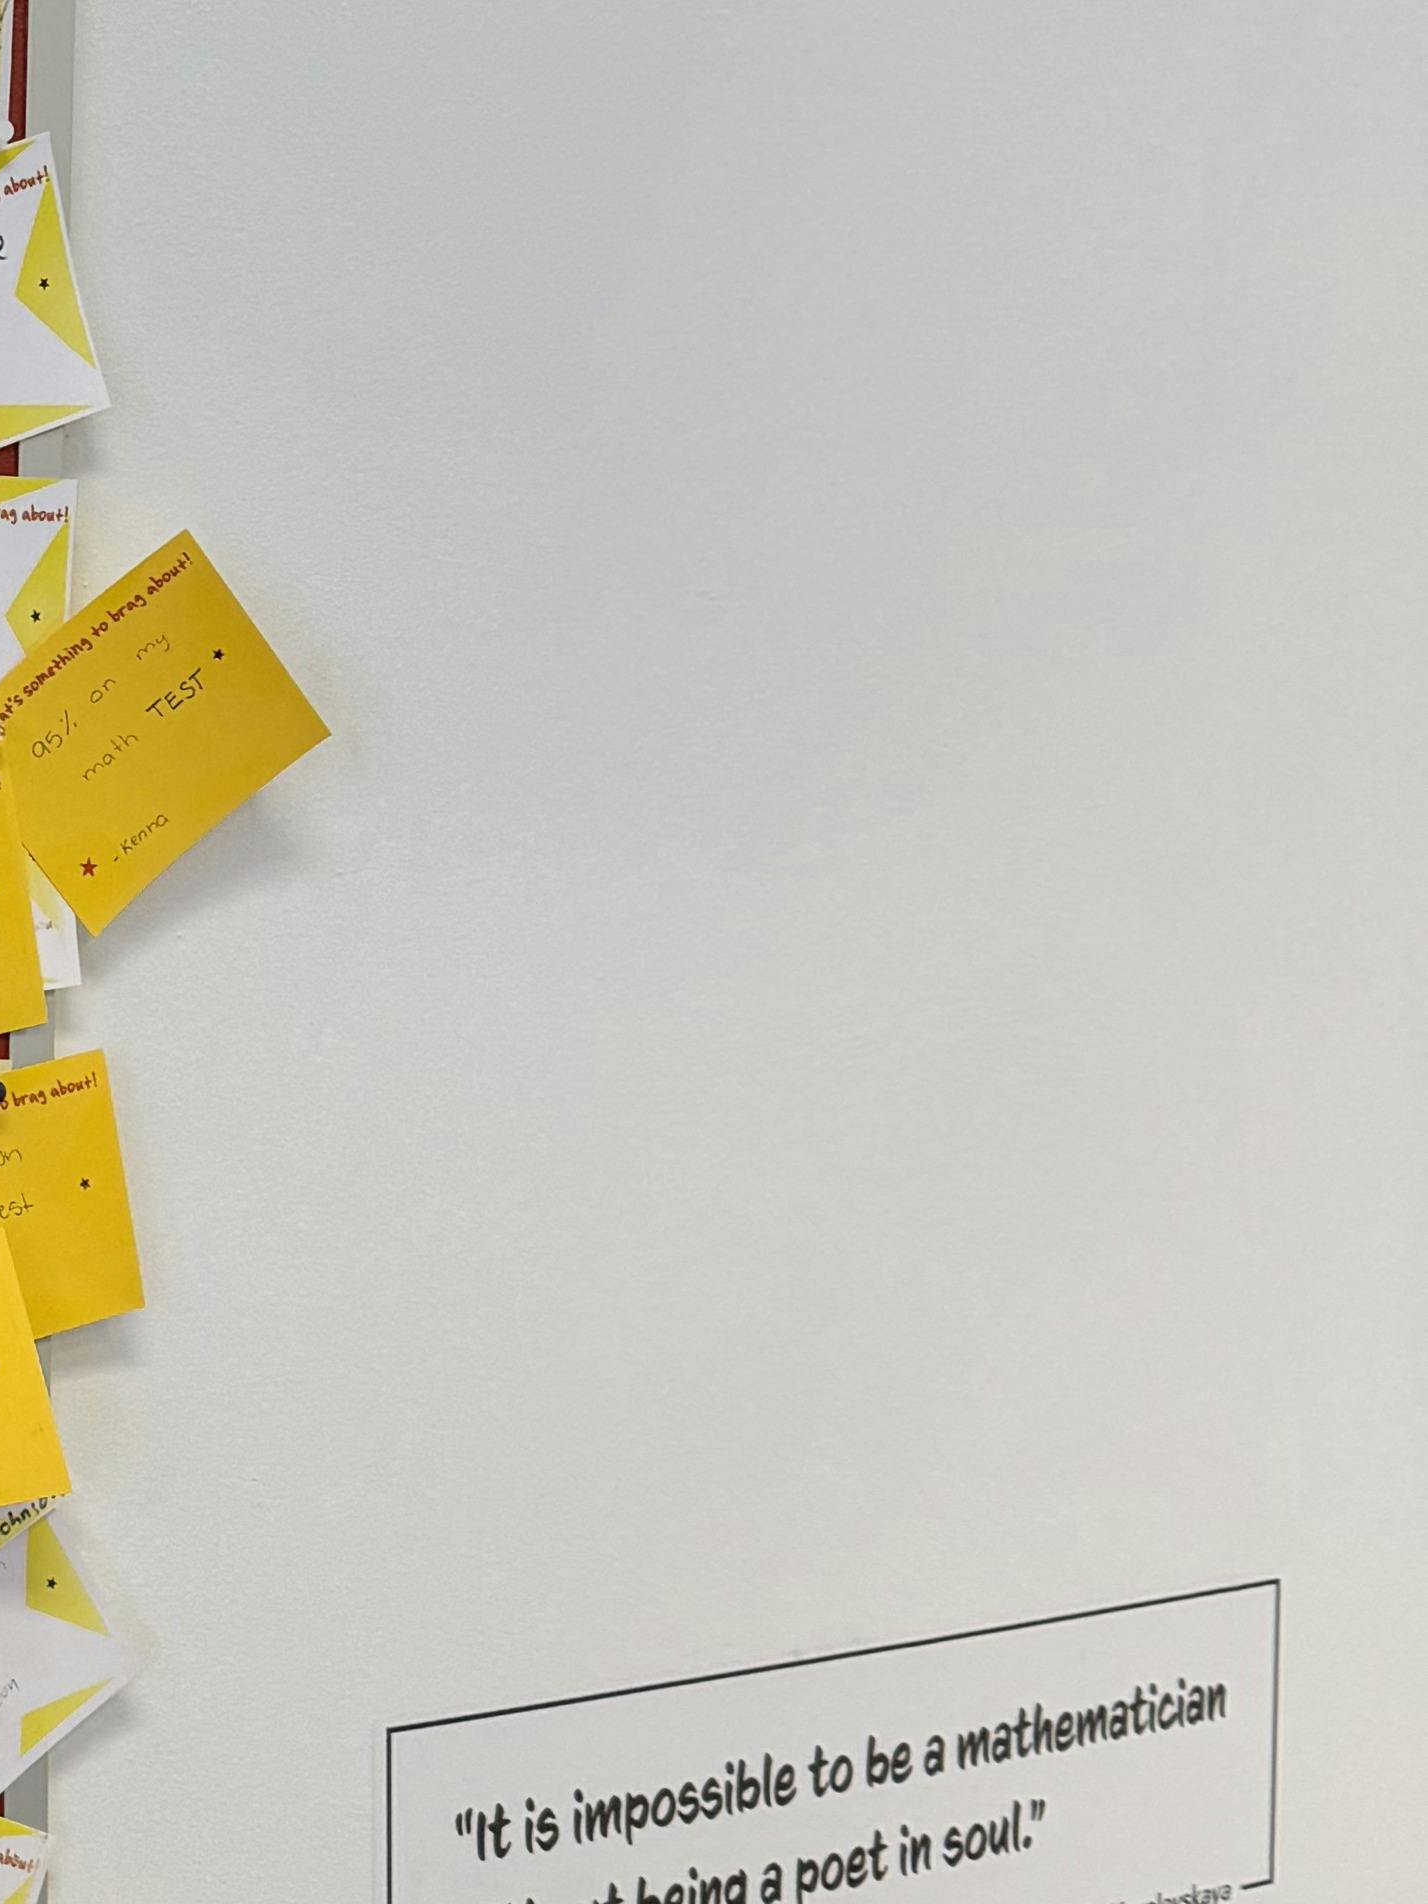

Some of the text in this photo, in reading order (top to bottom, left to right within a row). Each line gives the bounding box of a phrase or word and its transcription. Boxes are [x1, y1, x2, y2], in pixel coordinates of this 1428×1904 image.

[31, 635, 171, 759] 95% on my
[81, 669, 205, 781] math TEST
[524, 1798, 560, 1854] is
[573, 1751, 798, 1847] impossible
[809, 1744, 853, 1796] to
[865, 1734, 913, 1788] be
[924, 1739, 946, 1777] a
[957, 1676, 1228, 1771] mathematician
[760, 1862, 783, 1904] a
[899, 1825, 932, 1877] in
